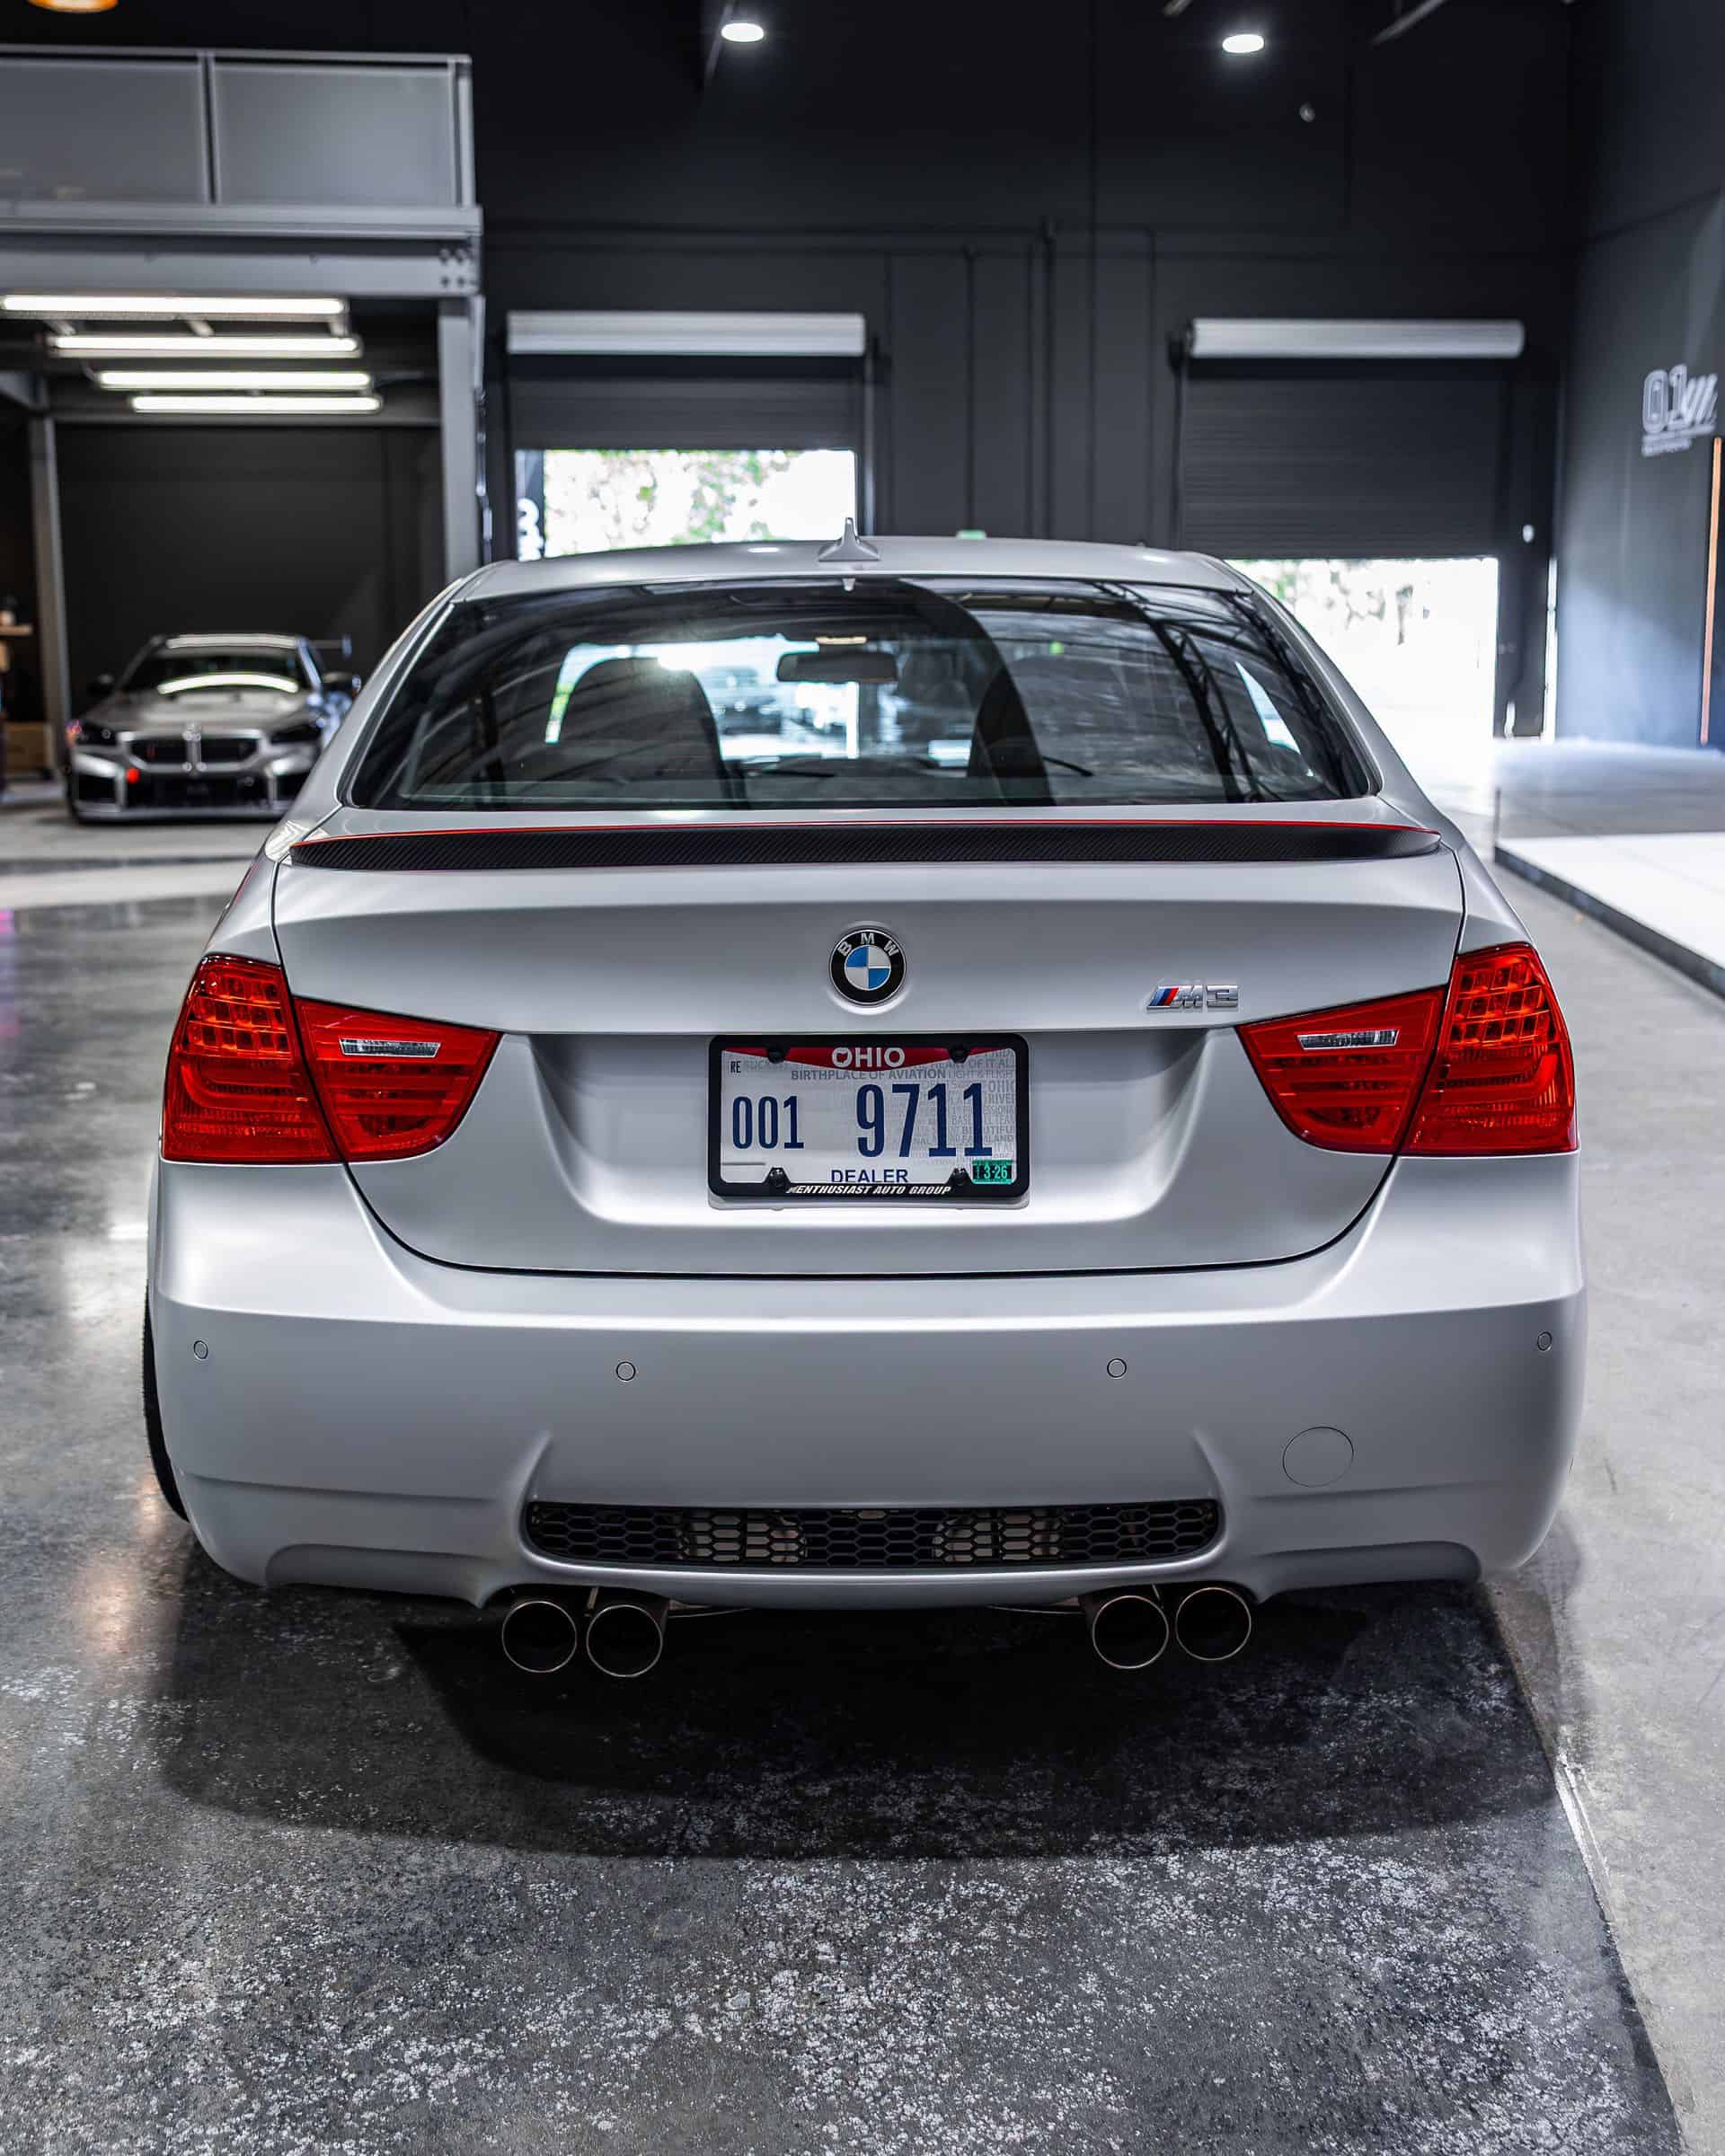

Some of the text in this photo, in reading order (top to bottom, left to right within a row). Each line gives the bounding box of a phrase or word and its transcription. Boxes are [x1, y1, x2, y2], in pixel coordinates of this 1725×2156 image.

[837, 932, 899, 956] BMW
[832, 1047, 906, 1068] OHIO
[730, 1061, 741, 1074] RE
[791, 1068, 944, 1081] BIRTHPLACE OF AVIATION
[732, 1095, 805, 1150] 001
[856, 1082, 993, 1158] 9711
[831, 1169, 909, 1183] DEALER
[796, 1185, 951, 1195] ENTHUSIAST AUTO GROUP
